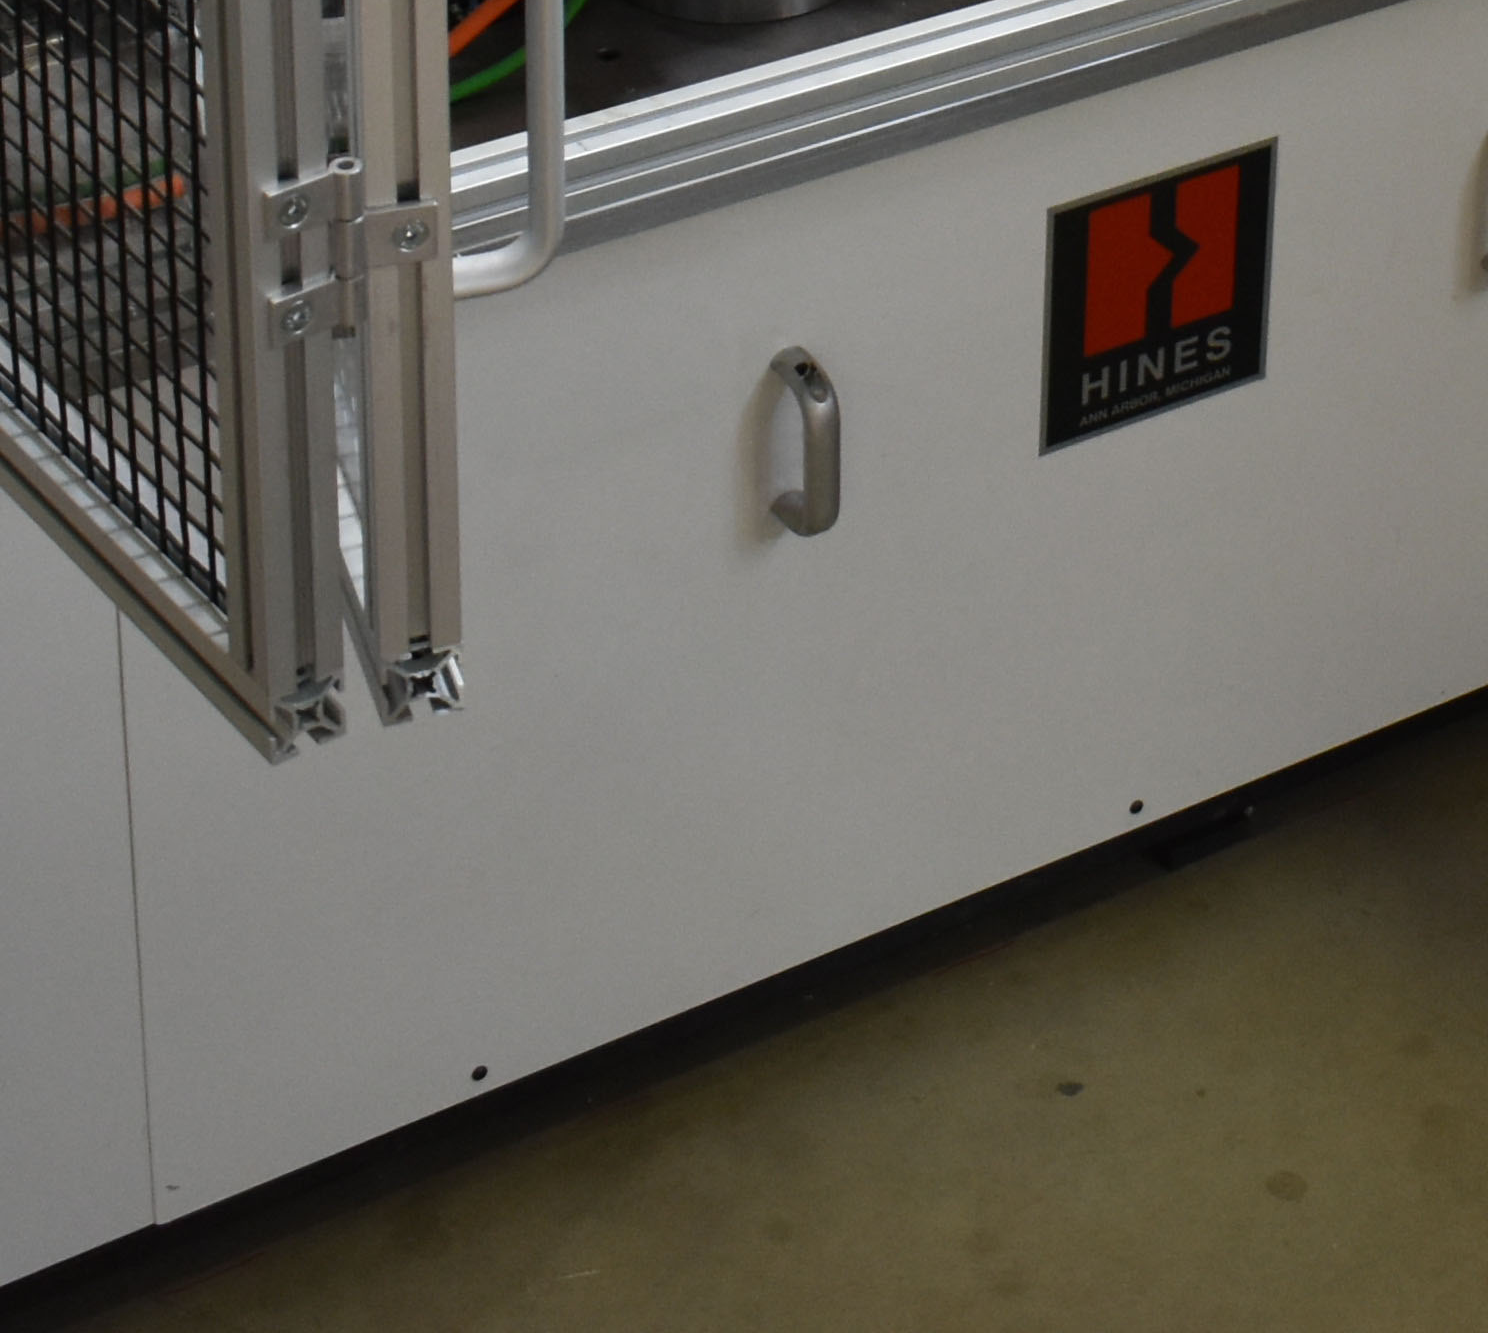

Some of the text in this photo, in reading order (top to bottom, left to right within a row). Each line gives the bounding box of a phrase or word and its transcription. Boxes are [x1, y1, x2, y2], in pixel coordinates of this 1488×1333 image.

[1079, 365, 1231, 428] ANN ARBOR, MICHIGAN
[1080, 326, 1232, 407] HINES
